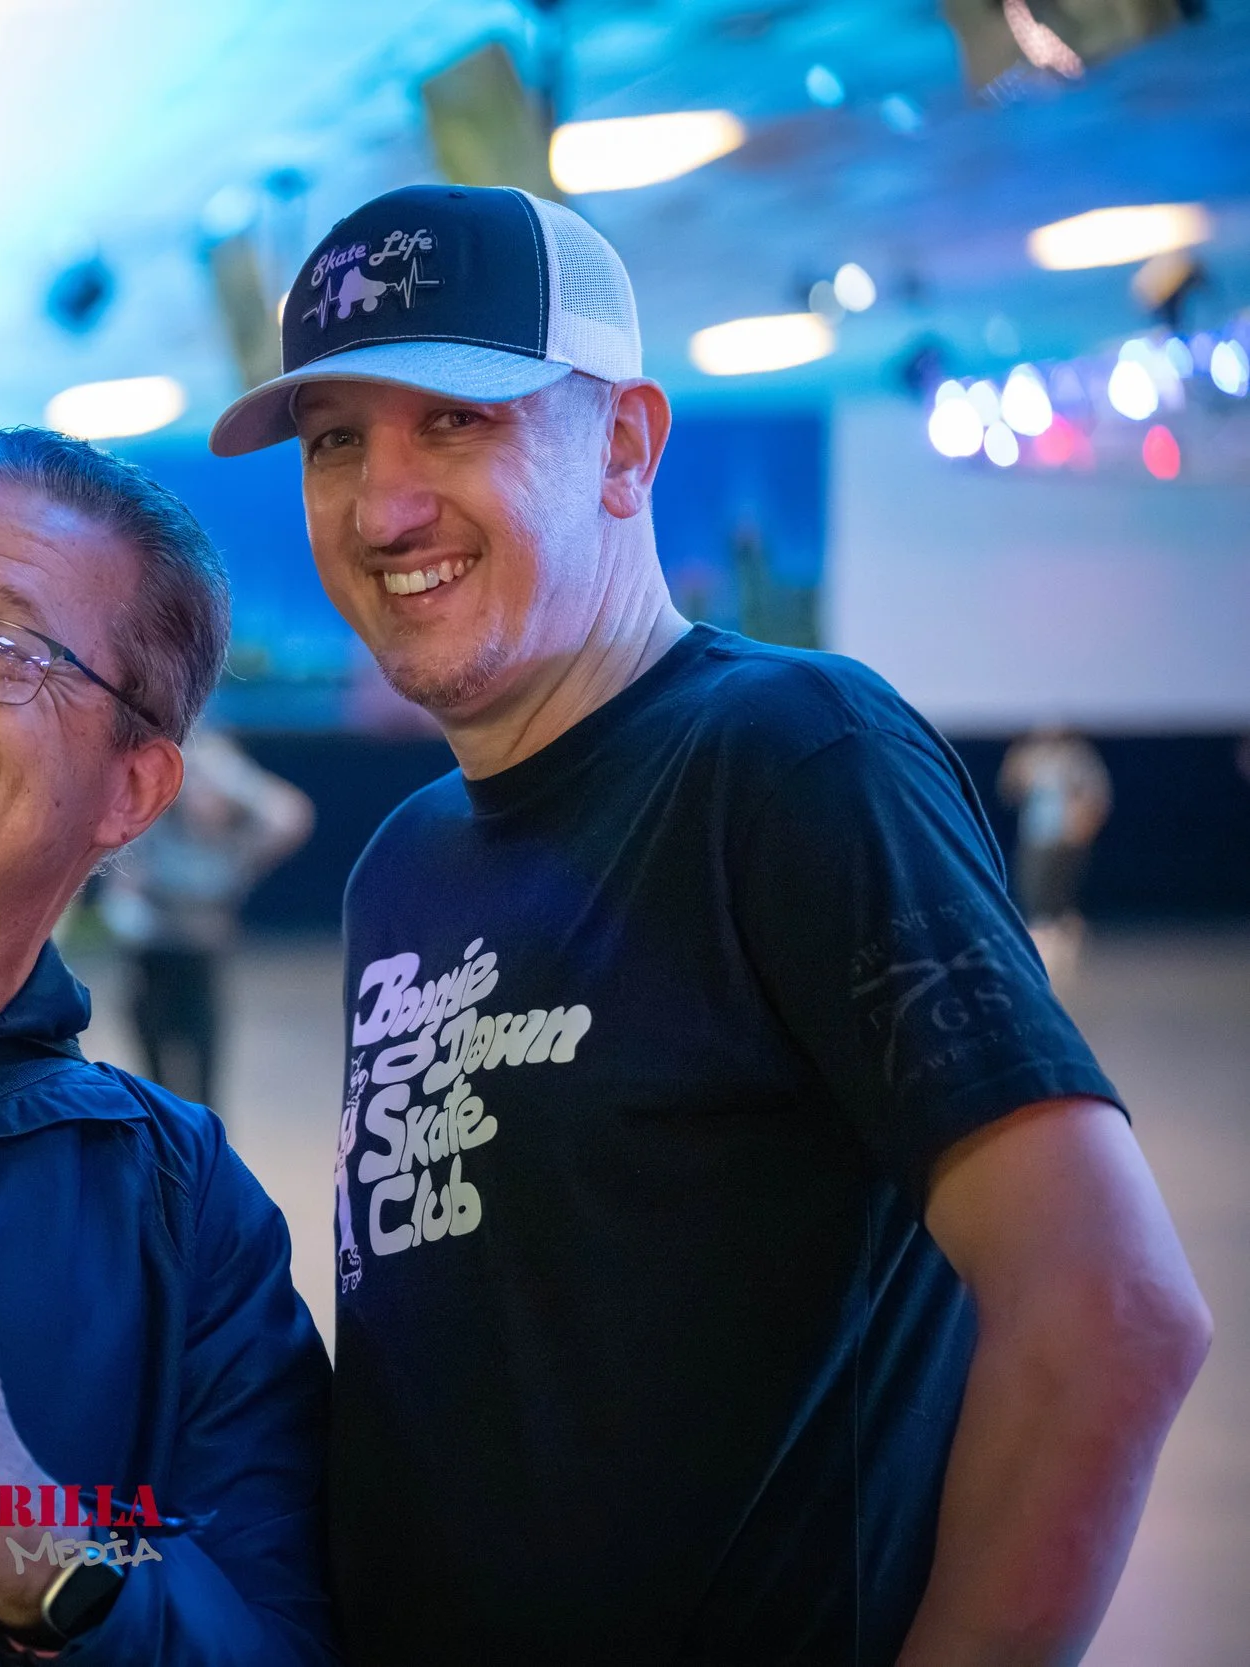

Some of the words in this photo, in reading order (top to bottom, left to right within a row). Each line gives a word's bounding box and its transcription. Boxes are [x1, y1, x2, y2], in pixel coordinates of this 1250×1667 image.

[310, 243, 367, 287] Skate
[368, 229, 433, 267] Life
[352, 937, 499, 1084] Boogie
[422, 1004, 592, 1095] Down
[357, 1073, 498, 1184] Skate
[369, 1154, 482, 1256] Club
